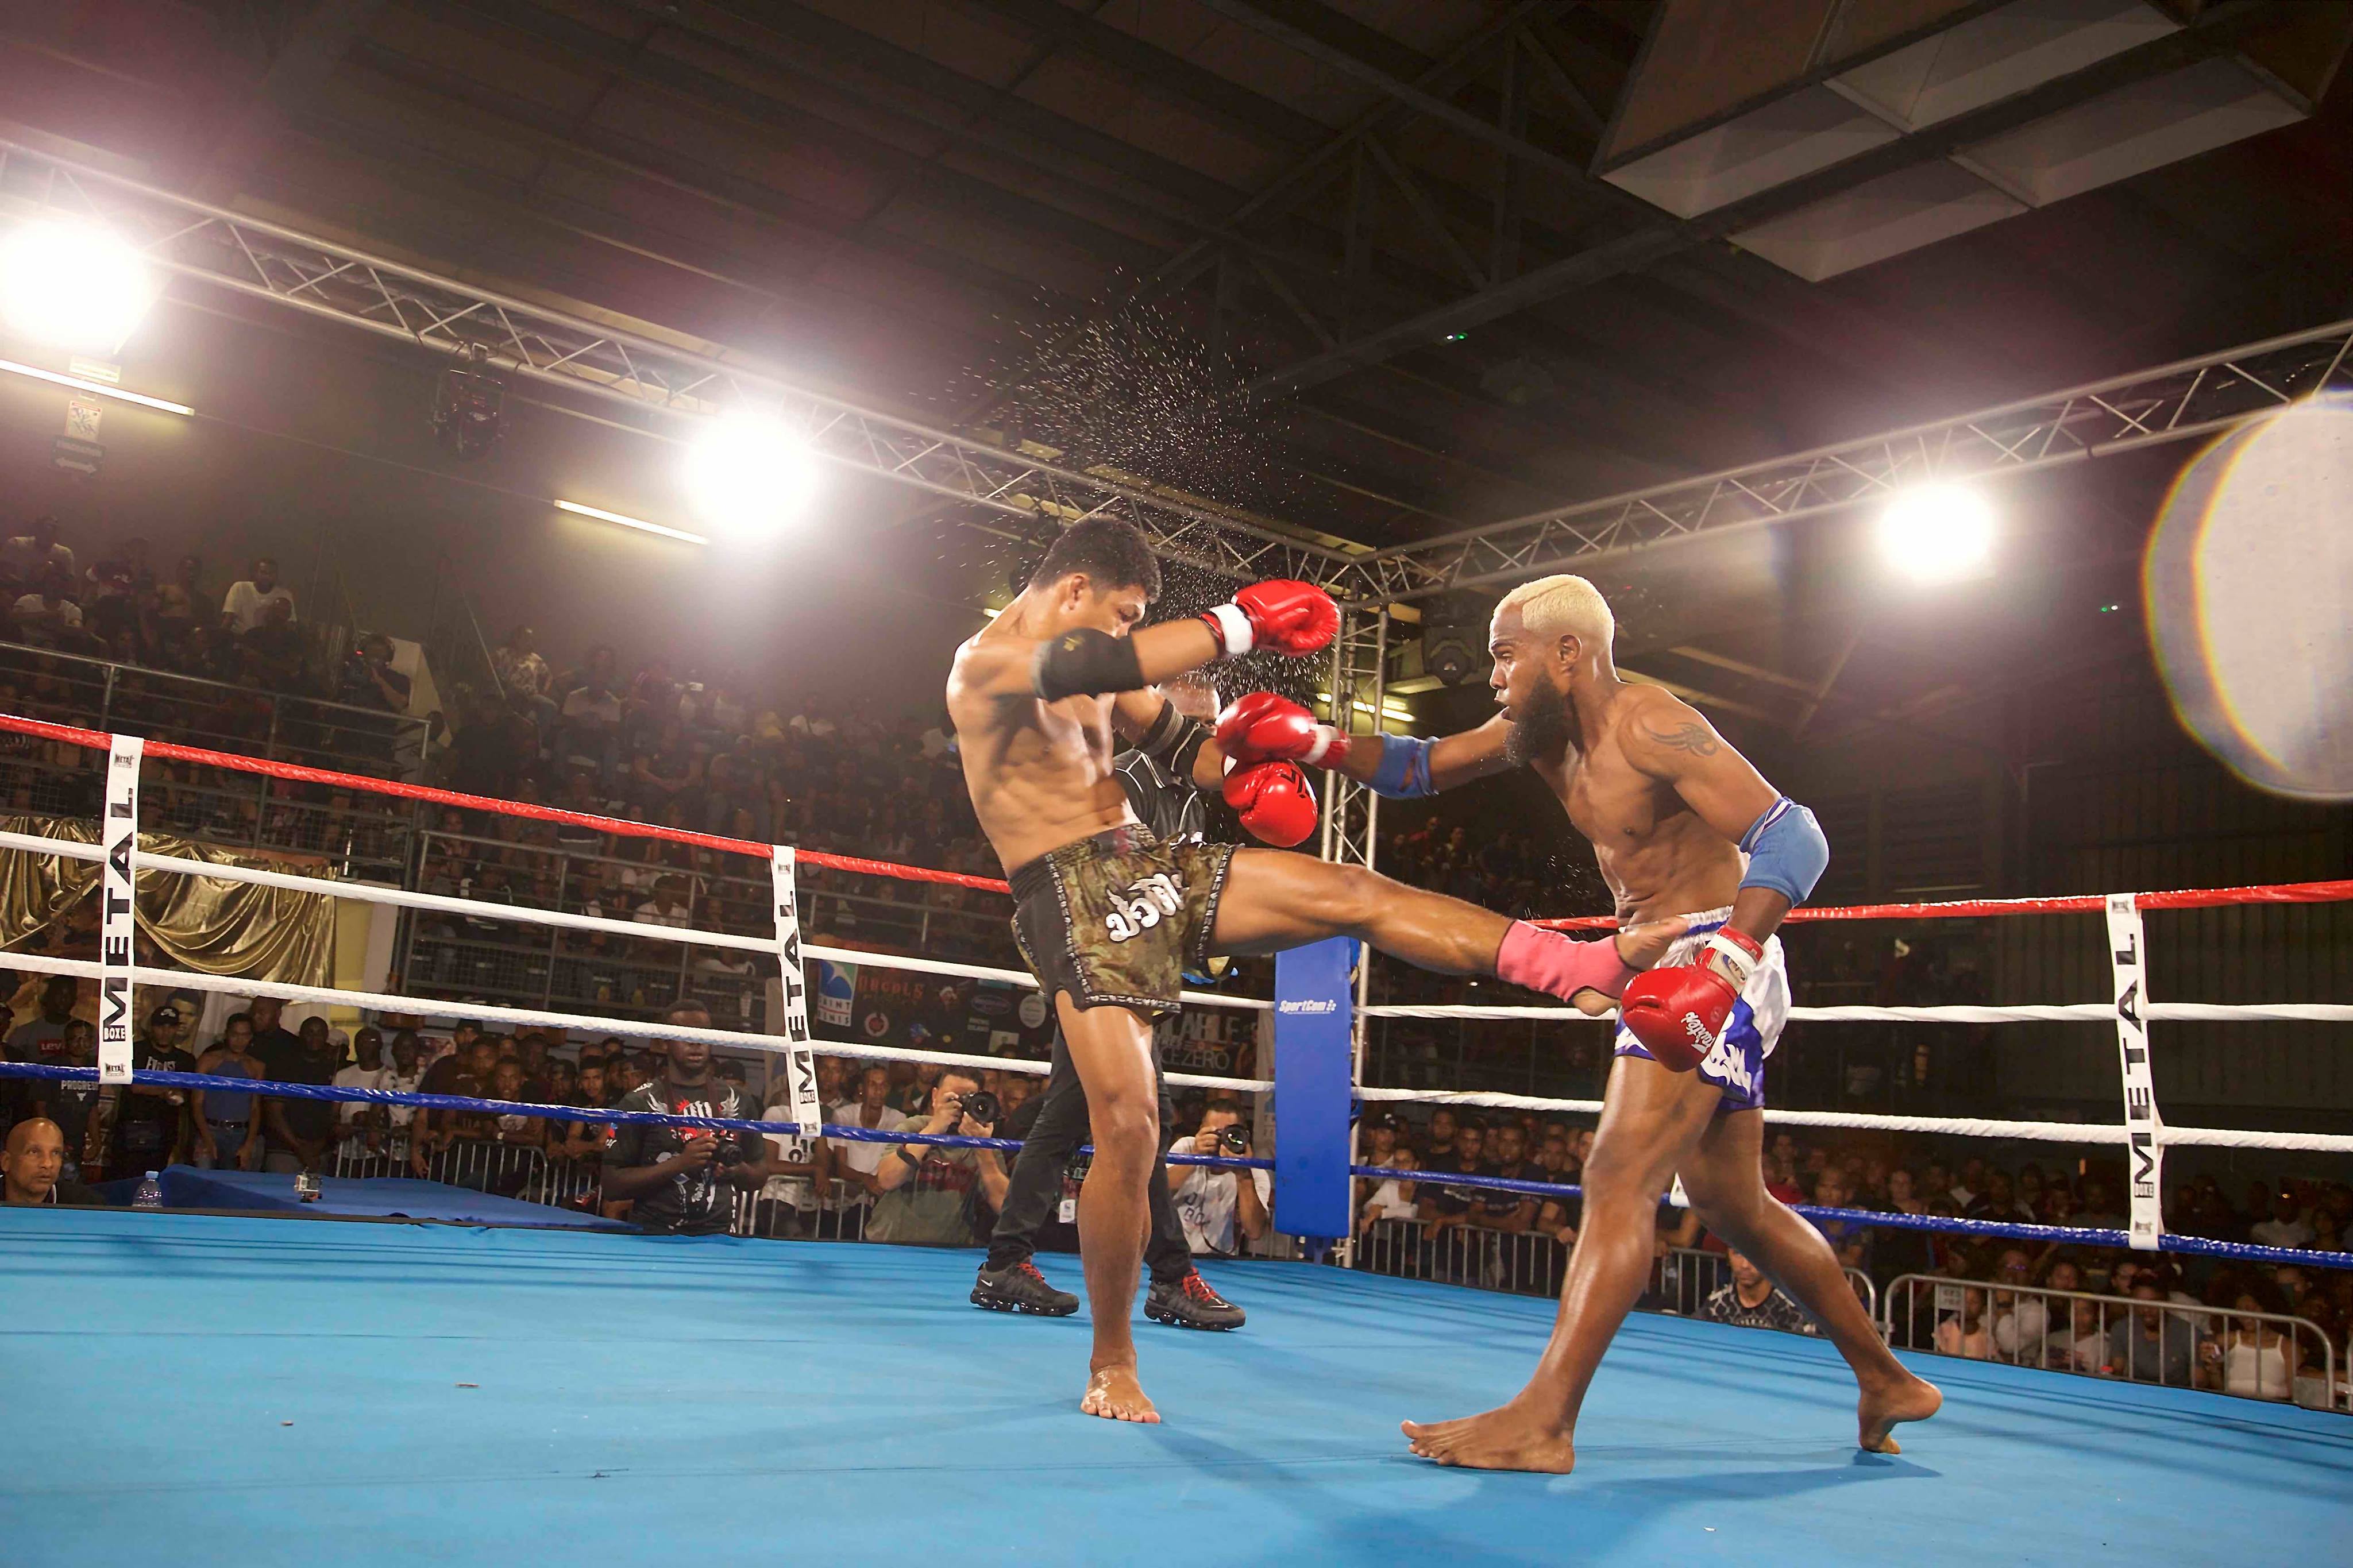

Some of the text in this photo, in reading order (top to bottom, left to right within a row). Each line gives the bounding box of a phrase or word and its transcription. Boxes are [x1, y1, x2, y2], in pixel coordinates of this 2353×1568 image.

[103, 788, 133, 1041] METAL
[104, 1027, 125, 1040] BOXE
[780, 891, 816, 1104] METAL
[1681, 1011, 1715, 1054] Fairtex
[105, 1063, 124, 1072] METAL
[2115, 934, 2153, 1198] METAL
